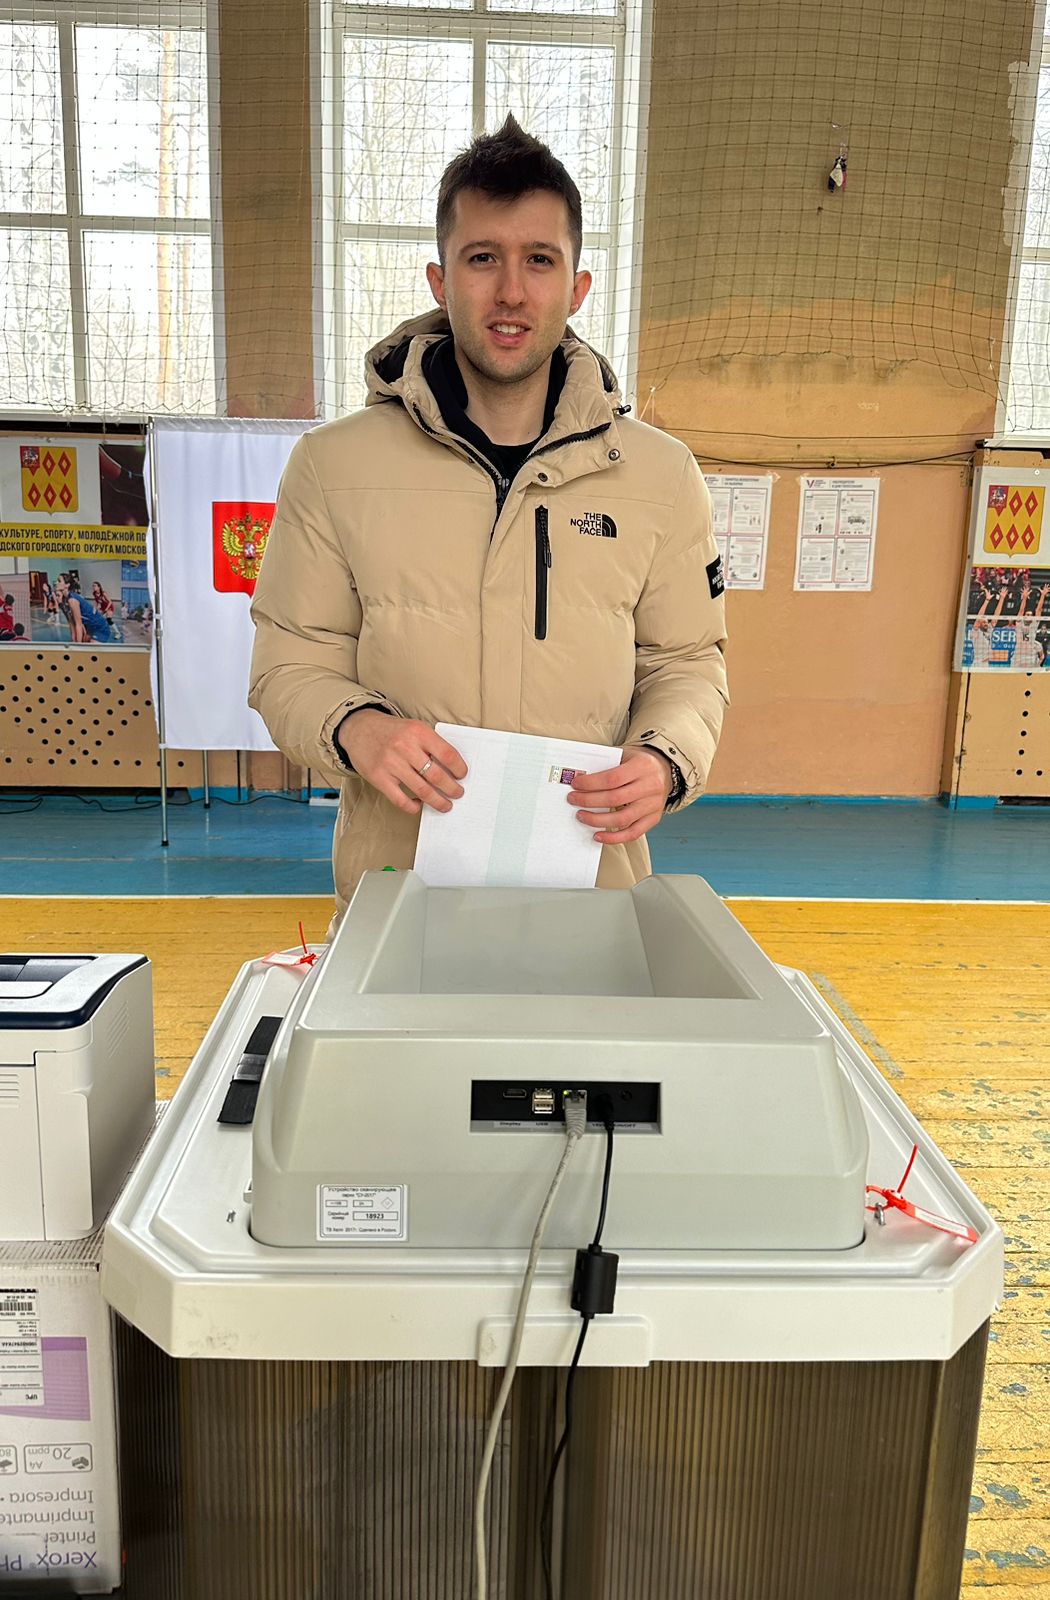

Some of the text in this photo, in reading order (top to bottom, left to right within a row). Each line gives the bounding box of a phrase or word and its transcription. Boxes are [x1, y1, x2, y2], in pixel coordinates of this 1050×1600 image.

[583, 512, 602, 521] THE
[570, 518, 602, 529] NORTH
[78, 529, 135, 542] МОЛОДЁЖНОЙ
[579, 527, 602, 537] FACE
[0, 541, 147, 555] ДСКОГО ГОРОДСКОГО ОКРУГА МОСКОВ
[25, 1393, 38, 1401] UPC
[28, 1447, 72, 1460] 20 ppm
[29, 1460, 43, 1470] A4
[9, 1487, 94, 1504] Impresora
[0, 1507, 95, 1525] Imprimante
[43, 1530, 96, 1545] Printer
